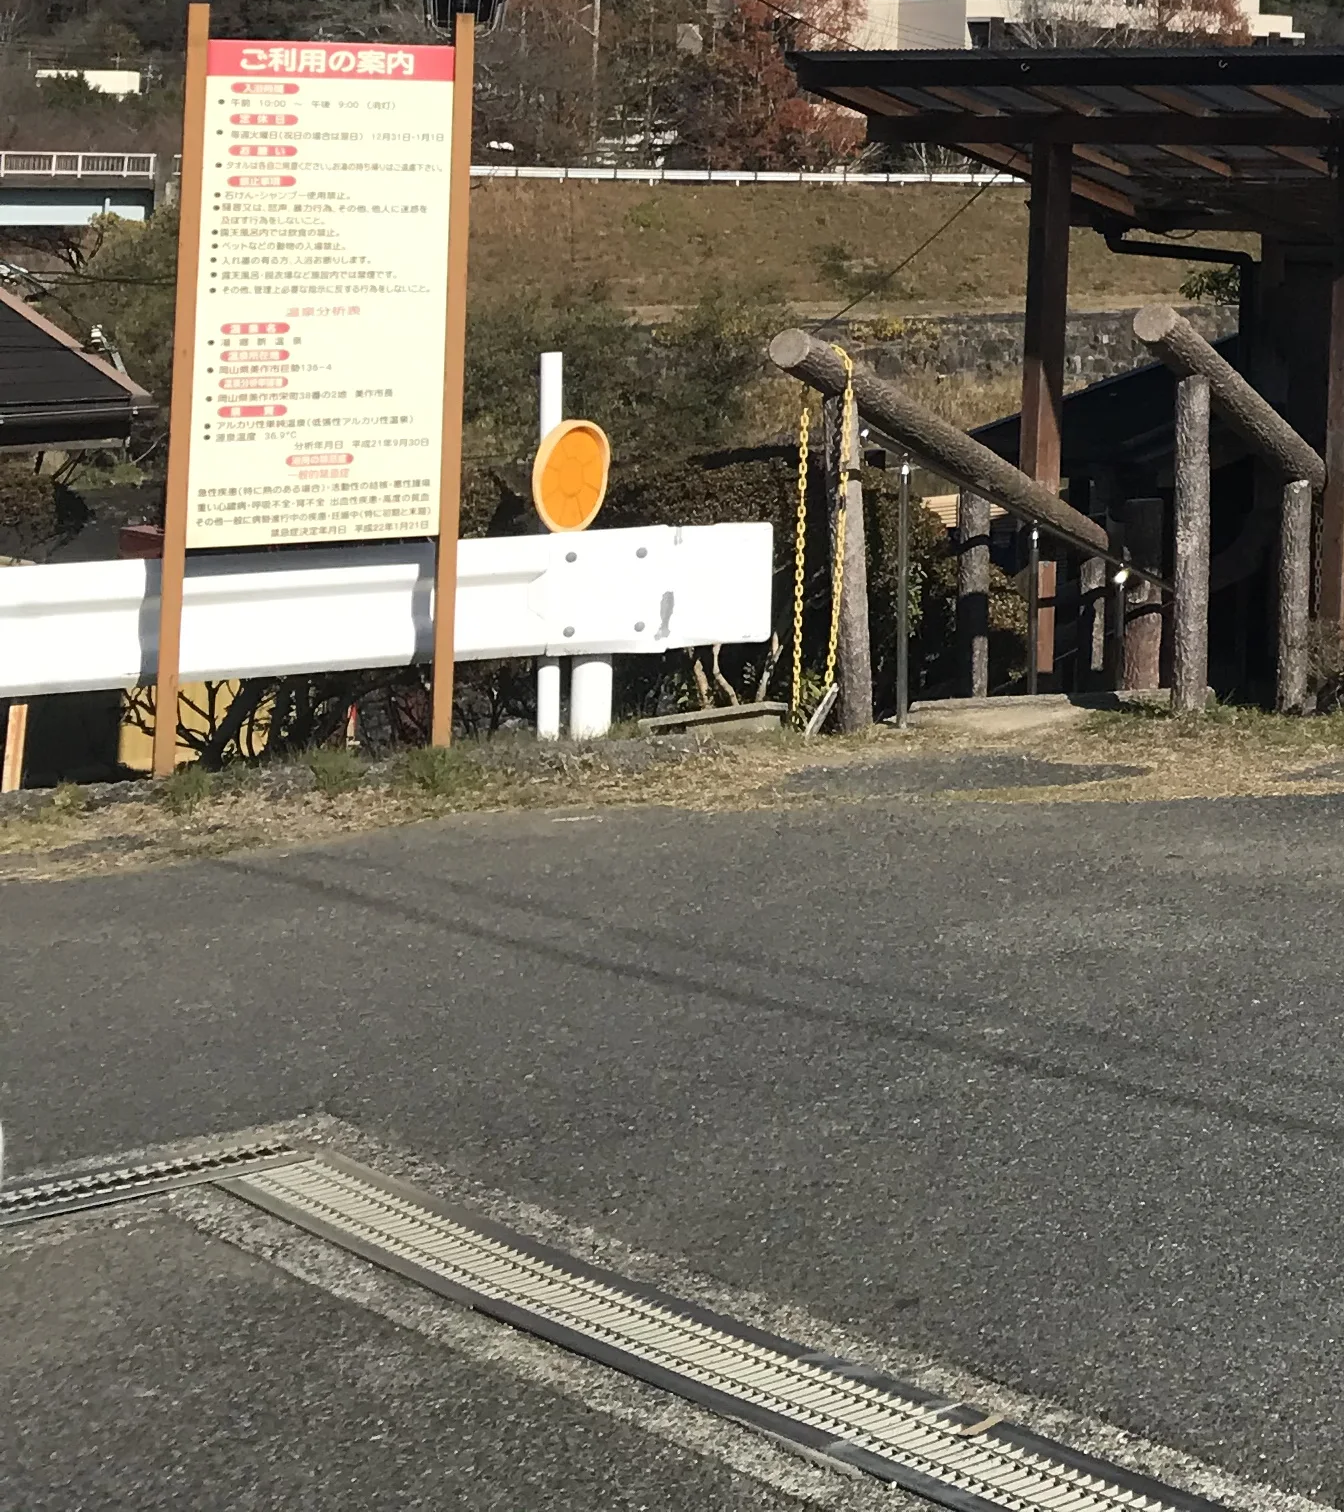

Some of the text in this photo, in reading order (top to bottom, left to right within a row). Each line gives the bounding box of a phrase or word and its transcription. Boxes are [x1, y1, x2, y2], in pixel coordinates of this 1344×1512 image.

[239, 47, 415, 76] ご利用の案内
[231, 98, 251, 108] 午前
[311, 100, 331, 109] 午後
[338, 101, 359, 109] 9:00
